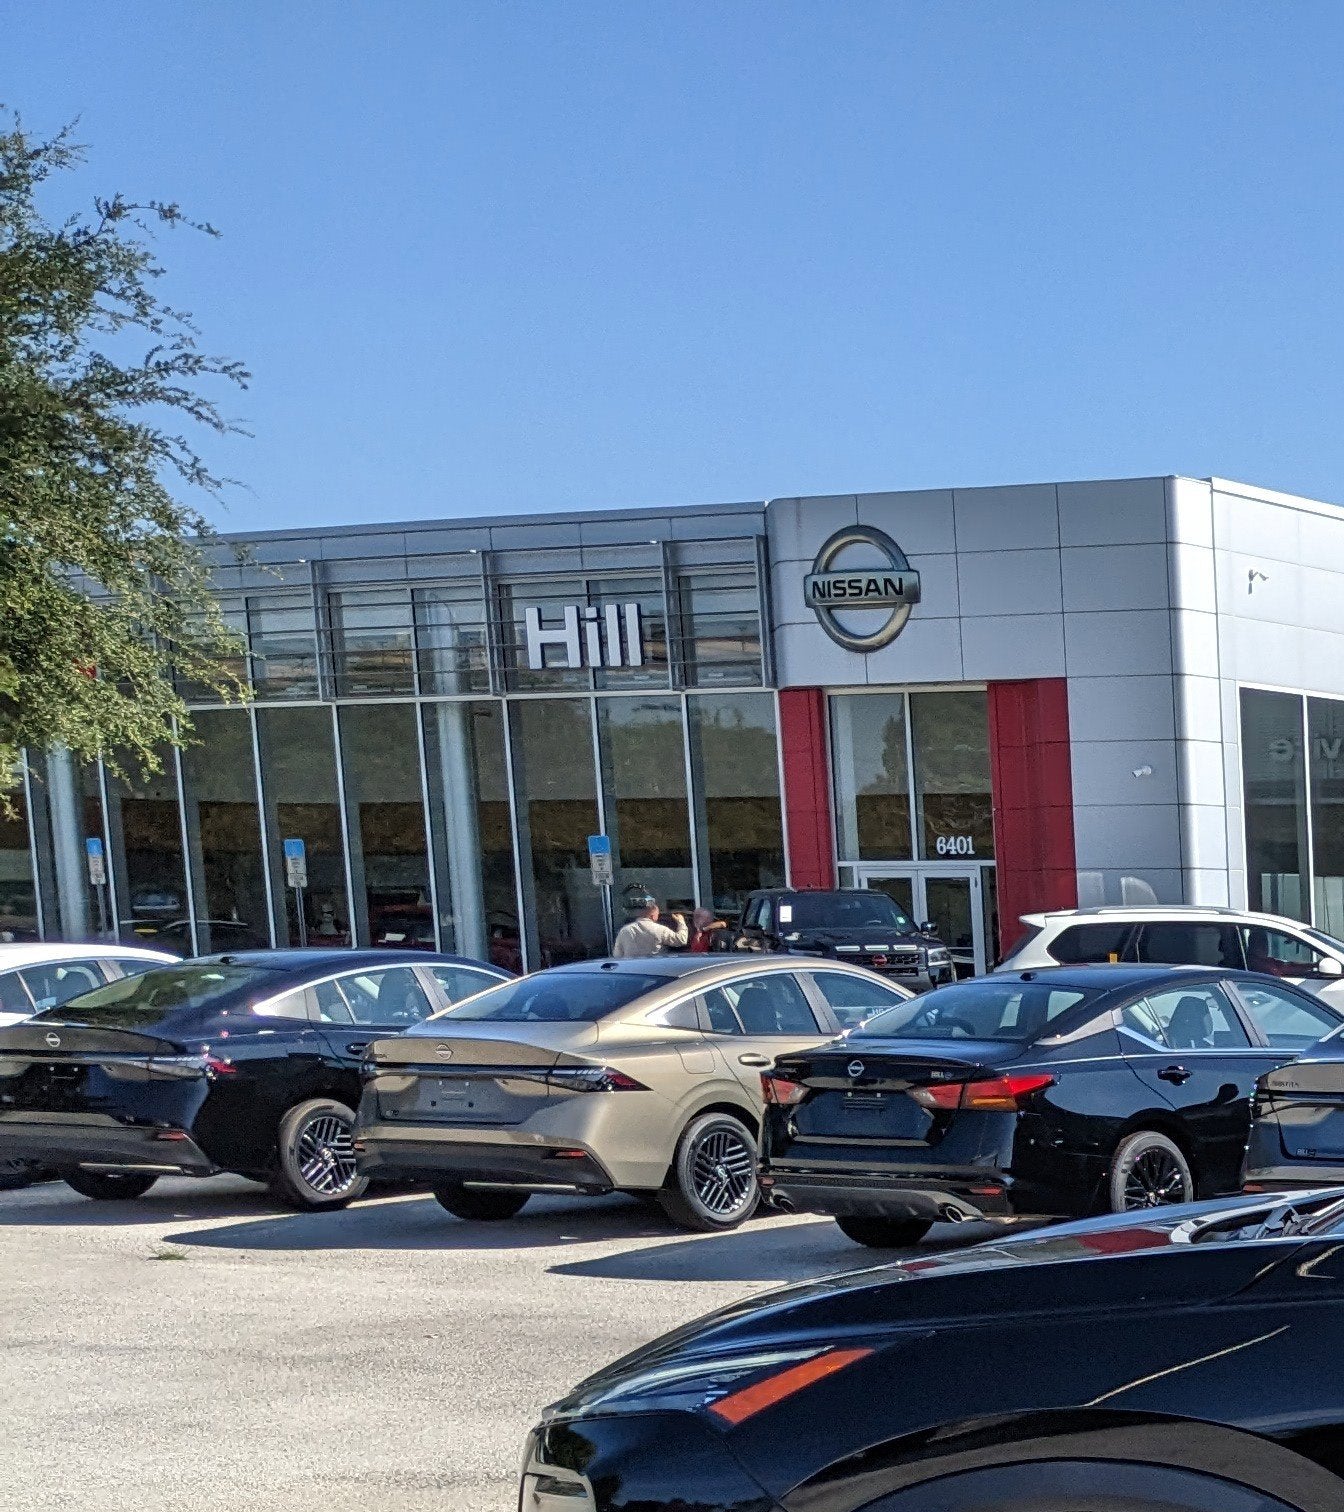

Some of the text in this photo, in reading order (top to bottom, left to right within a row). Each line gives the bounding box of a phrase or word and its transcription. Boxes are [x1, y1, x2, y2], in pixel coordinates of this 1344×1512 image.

[812, 578, 904, 599] NISSAN
[525, 603, 642, 669] Hill
[936, 835, 976, 855] 6401
